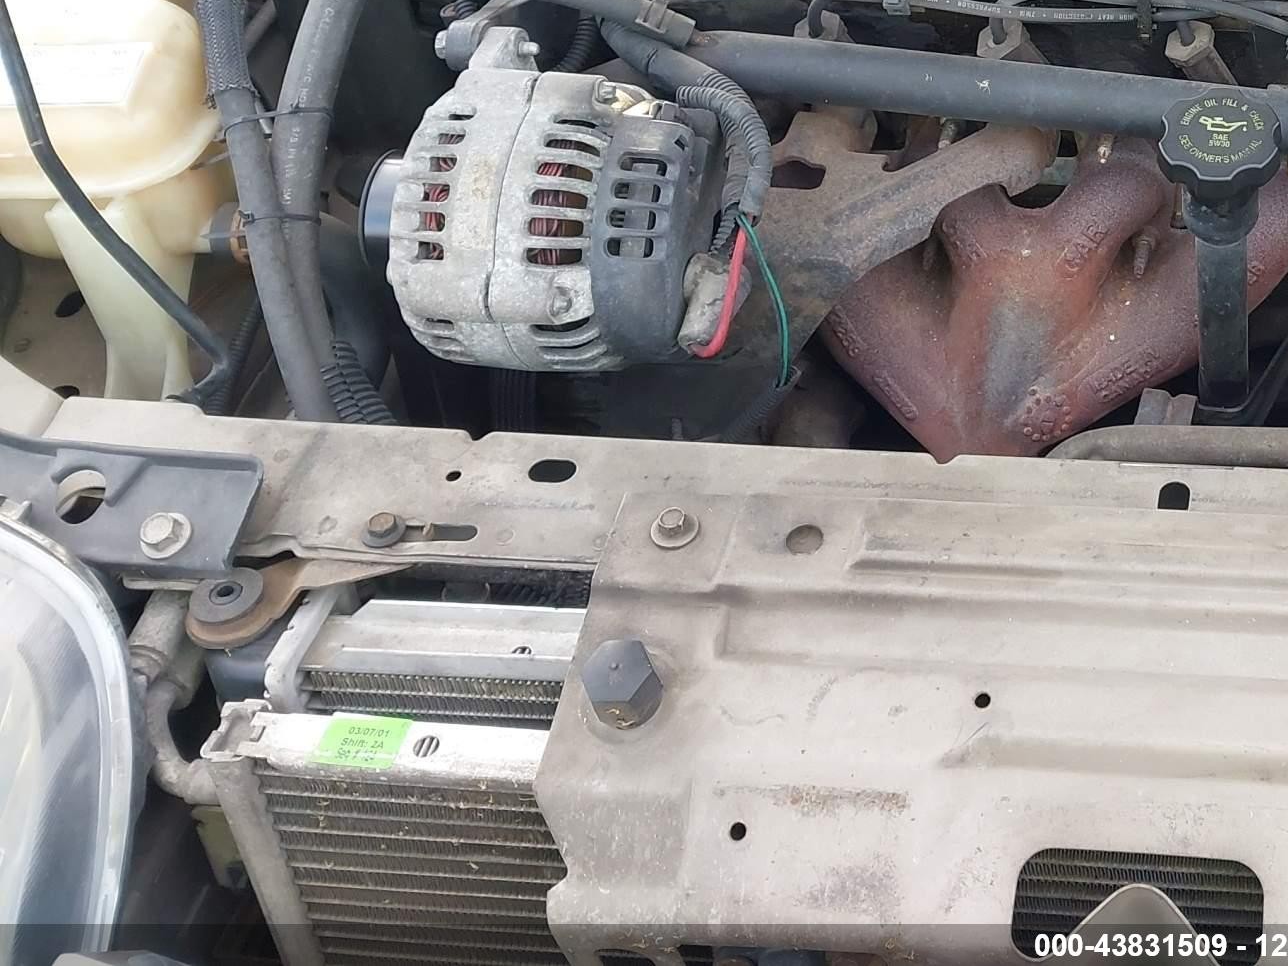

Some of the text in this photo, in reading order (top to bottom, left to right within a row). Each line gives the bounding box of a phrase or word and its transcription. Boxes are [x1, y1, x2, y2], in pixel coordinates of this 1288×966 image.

[1181, 104, 1204, 126] ENGINE
[1204, 98, 1218, 108] OIL
[1222, 98, 1238, 108] FILL
[1212, 133, 1229, 141] SAE
[1178, 134, 1192, 150] SEE
[1189, 147, 1230, 163] OWNER'S
[1208, 140, 1231, 148] 5W30
[348, 726, 391, 739] 03/07/01
[340, 737, 369, 748] Shift:
